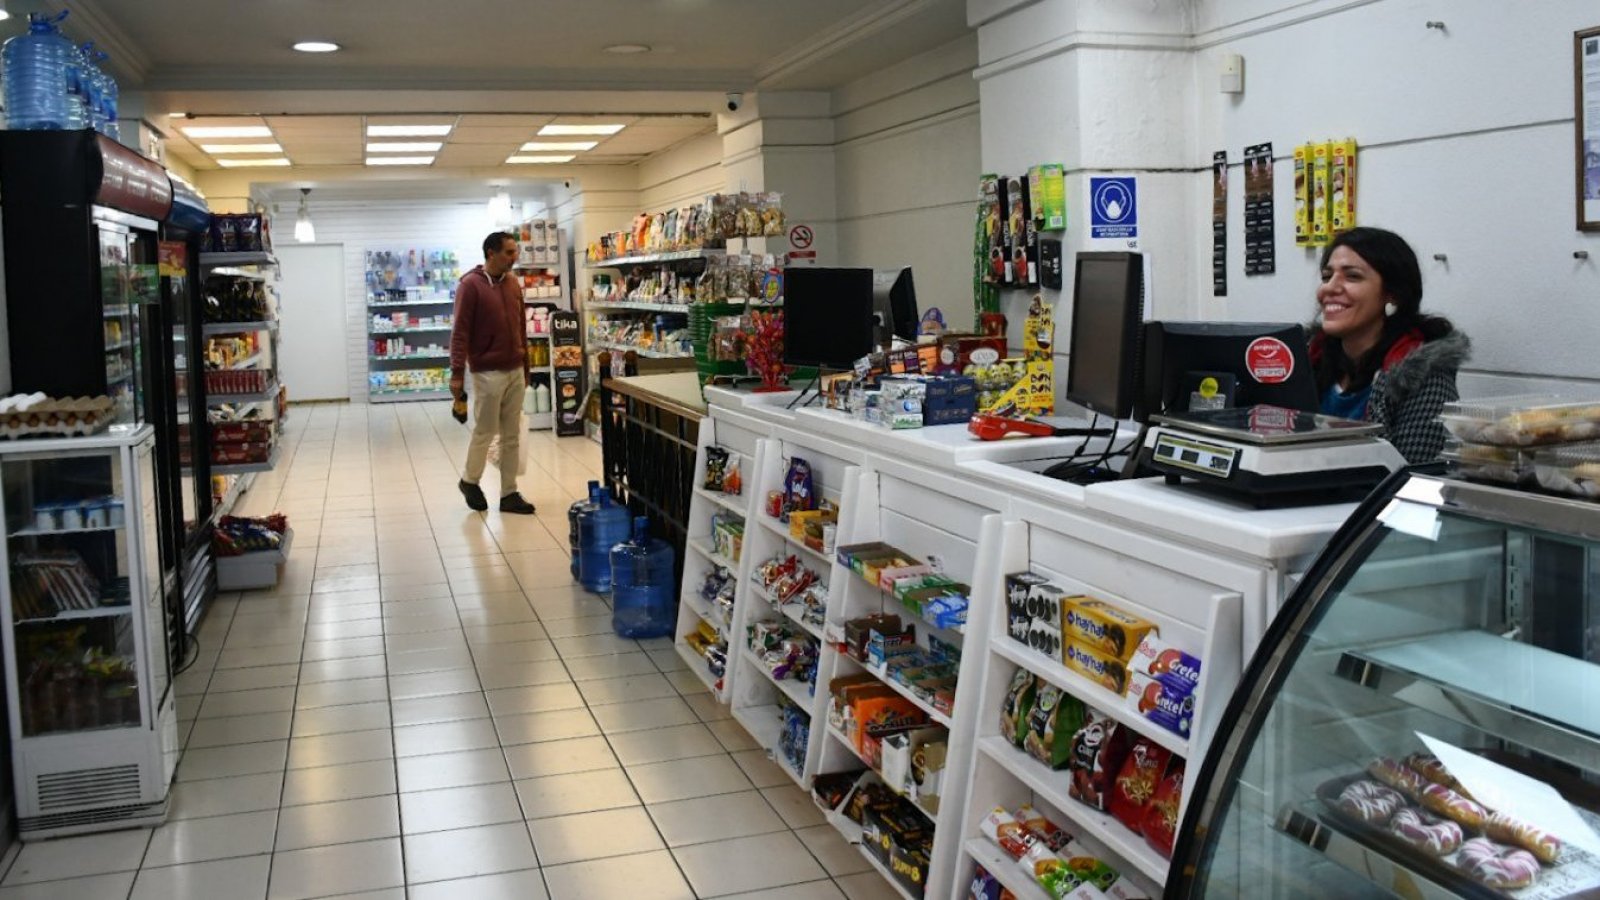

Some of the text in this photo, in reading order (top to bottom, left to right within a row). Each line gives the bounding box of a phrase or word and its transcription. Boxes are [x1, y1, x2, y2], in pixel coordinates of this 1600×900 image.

[554, 319, 578, 329] tika
[1169, 659, 1198, 681] Grete
[1154, 692, 1183, 715] Gretel
